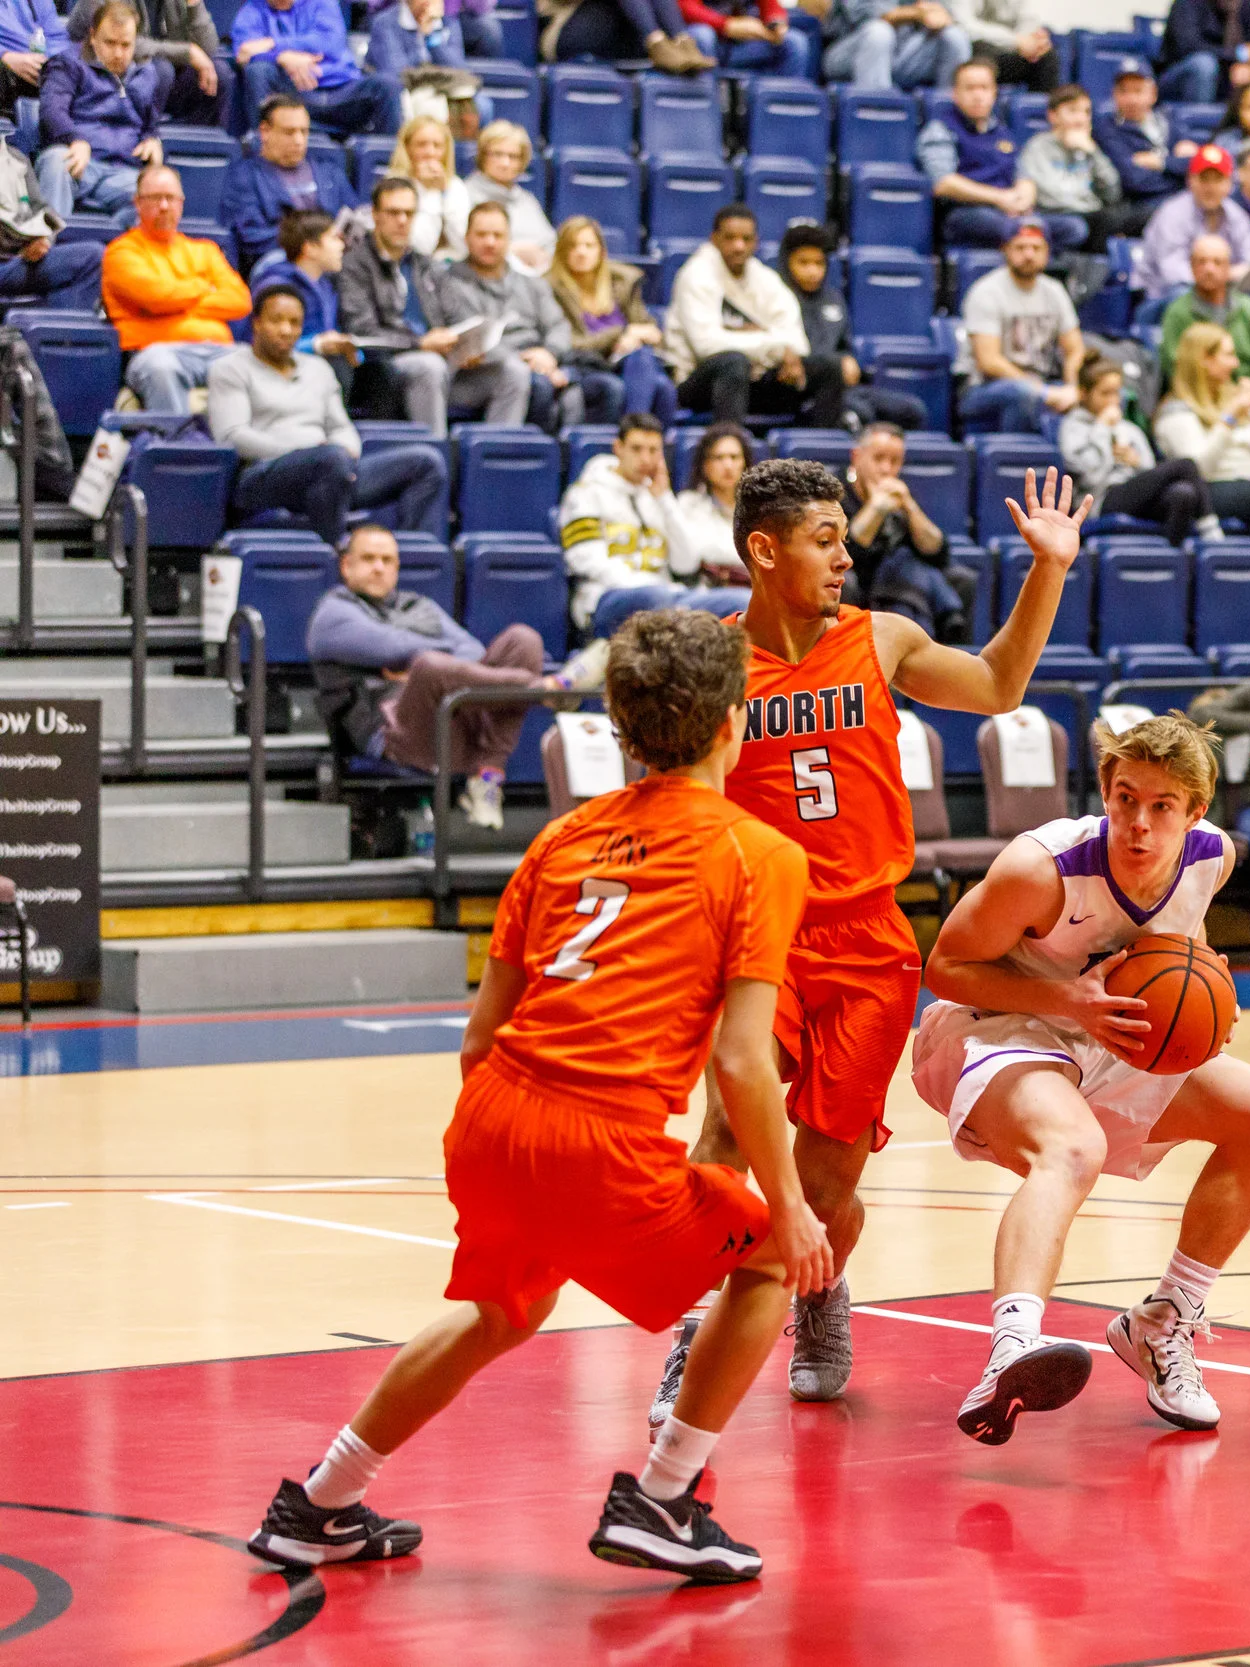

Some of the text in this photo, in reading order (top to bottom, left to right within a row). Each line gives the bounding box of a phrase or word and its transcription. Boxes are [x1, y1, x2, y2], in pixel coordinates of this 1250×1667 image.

[743, 683, 866, 742] NORTH
[790, 746, 838, 822] 5
[543, 877, 632, 981] 2
